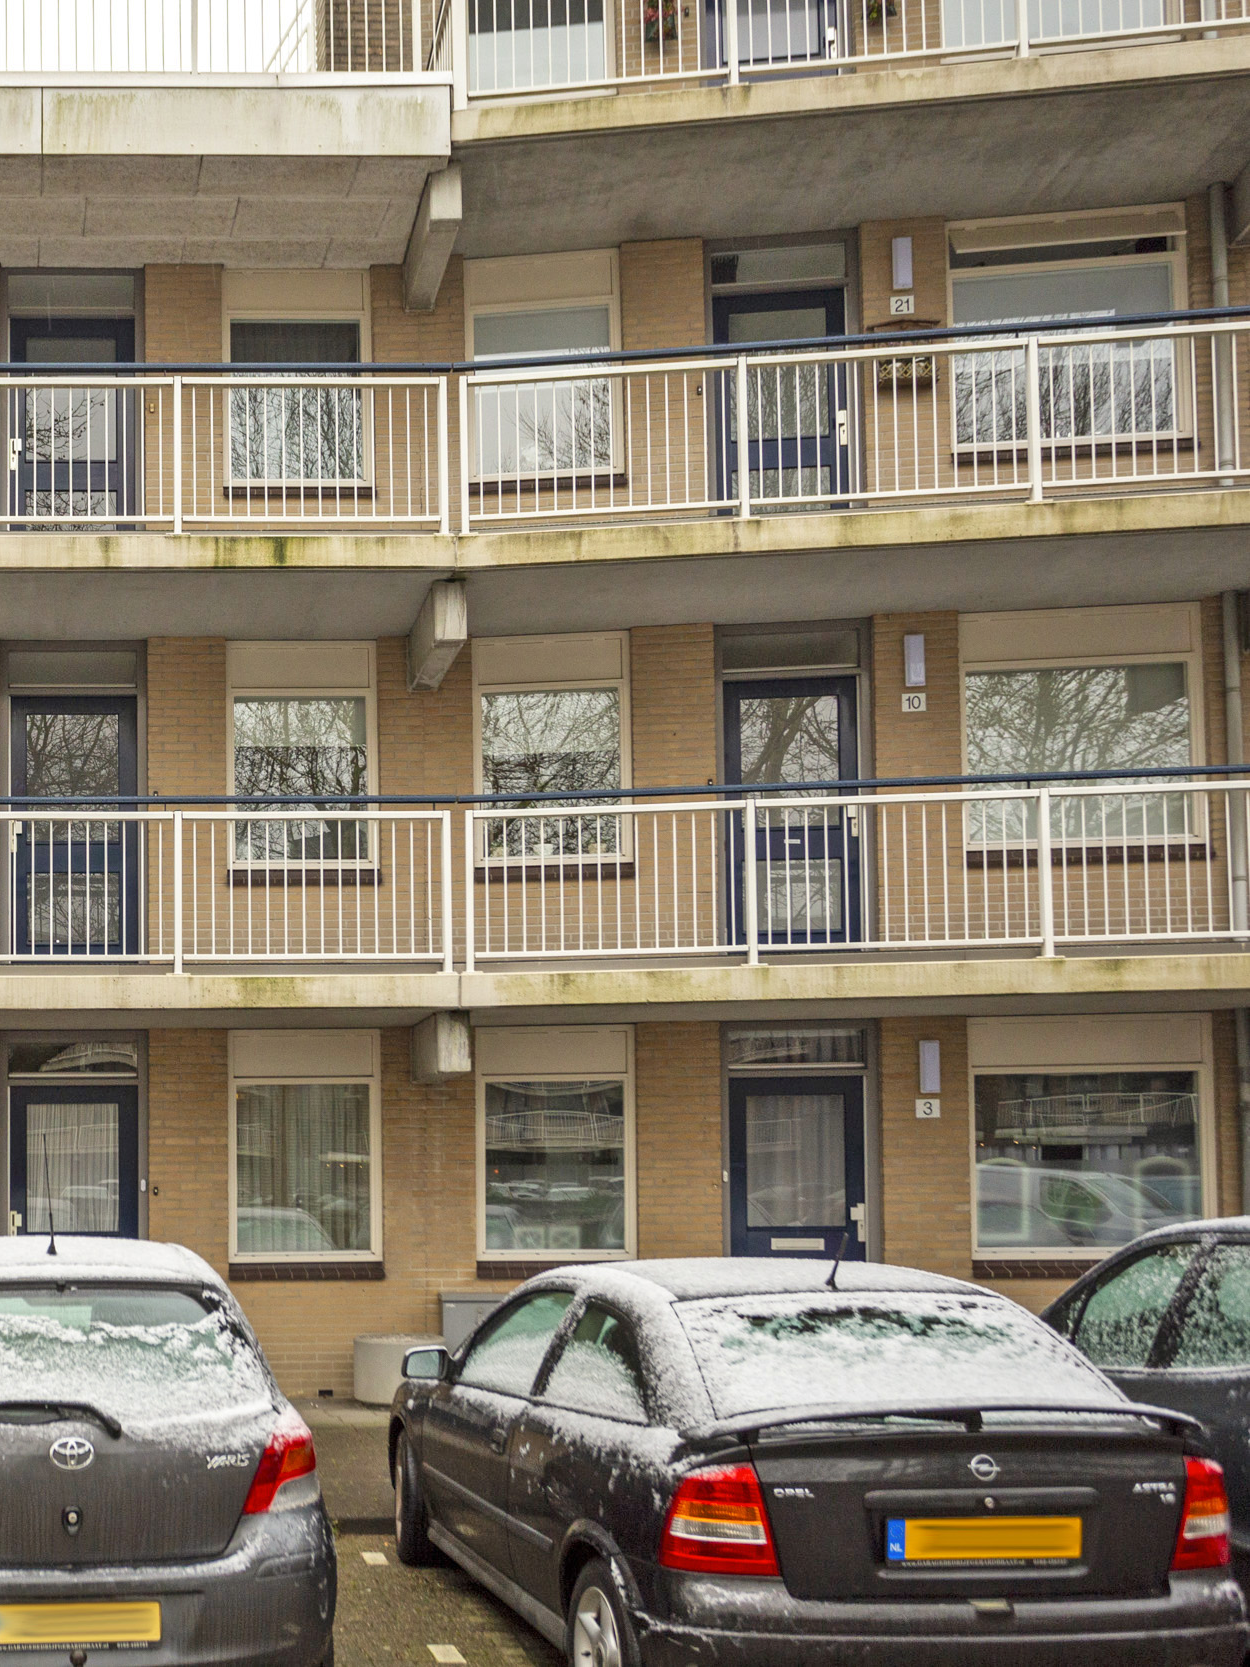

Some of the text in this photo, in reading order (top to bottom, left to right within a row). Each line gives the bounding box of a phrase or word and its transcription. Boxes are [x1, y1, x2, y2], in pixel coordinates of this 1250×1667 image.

[895, 298, 910, 312] 21
[905, 695, 921, 709] 10
[923, 1101, 933, 1116] 3
[773, 1487, 815, 1498] OPEL
[1132, 1482, 1176, 1494] ASTRA
[890, 1543, 903, 1552] NL
